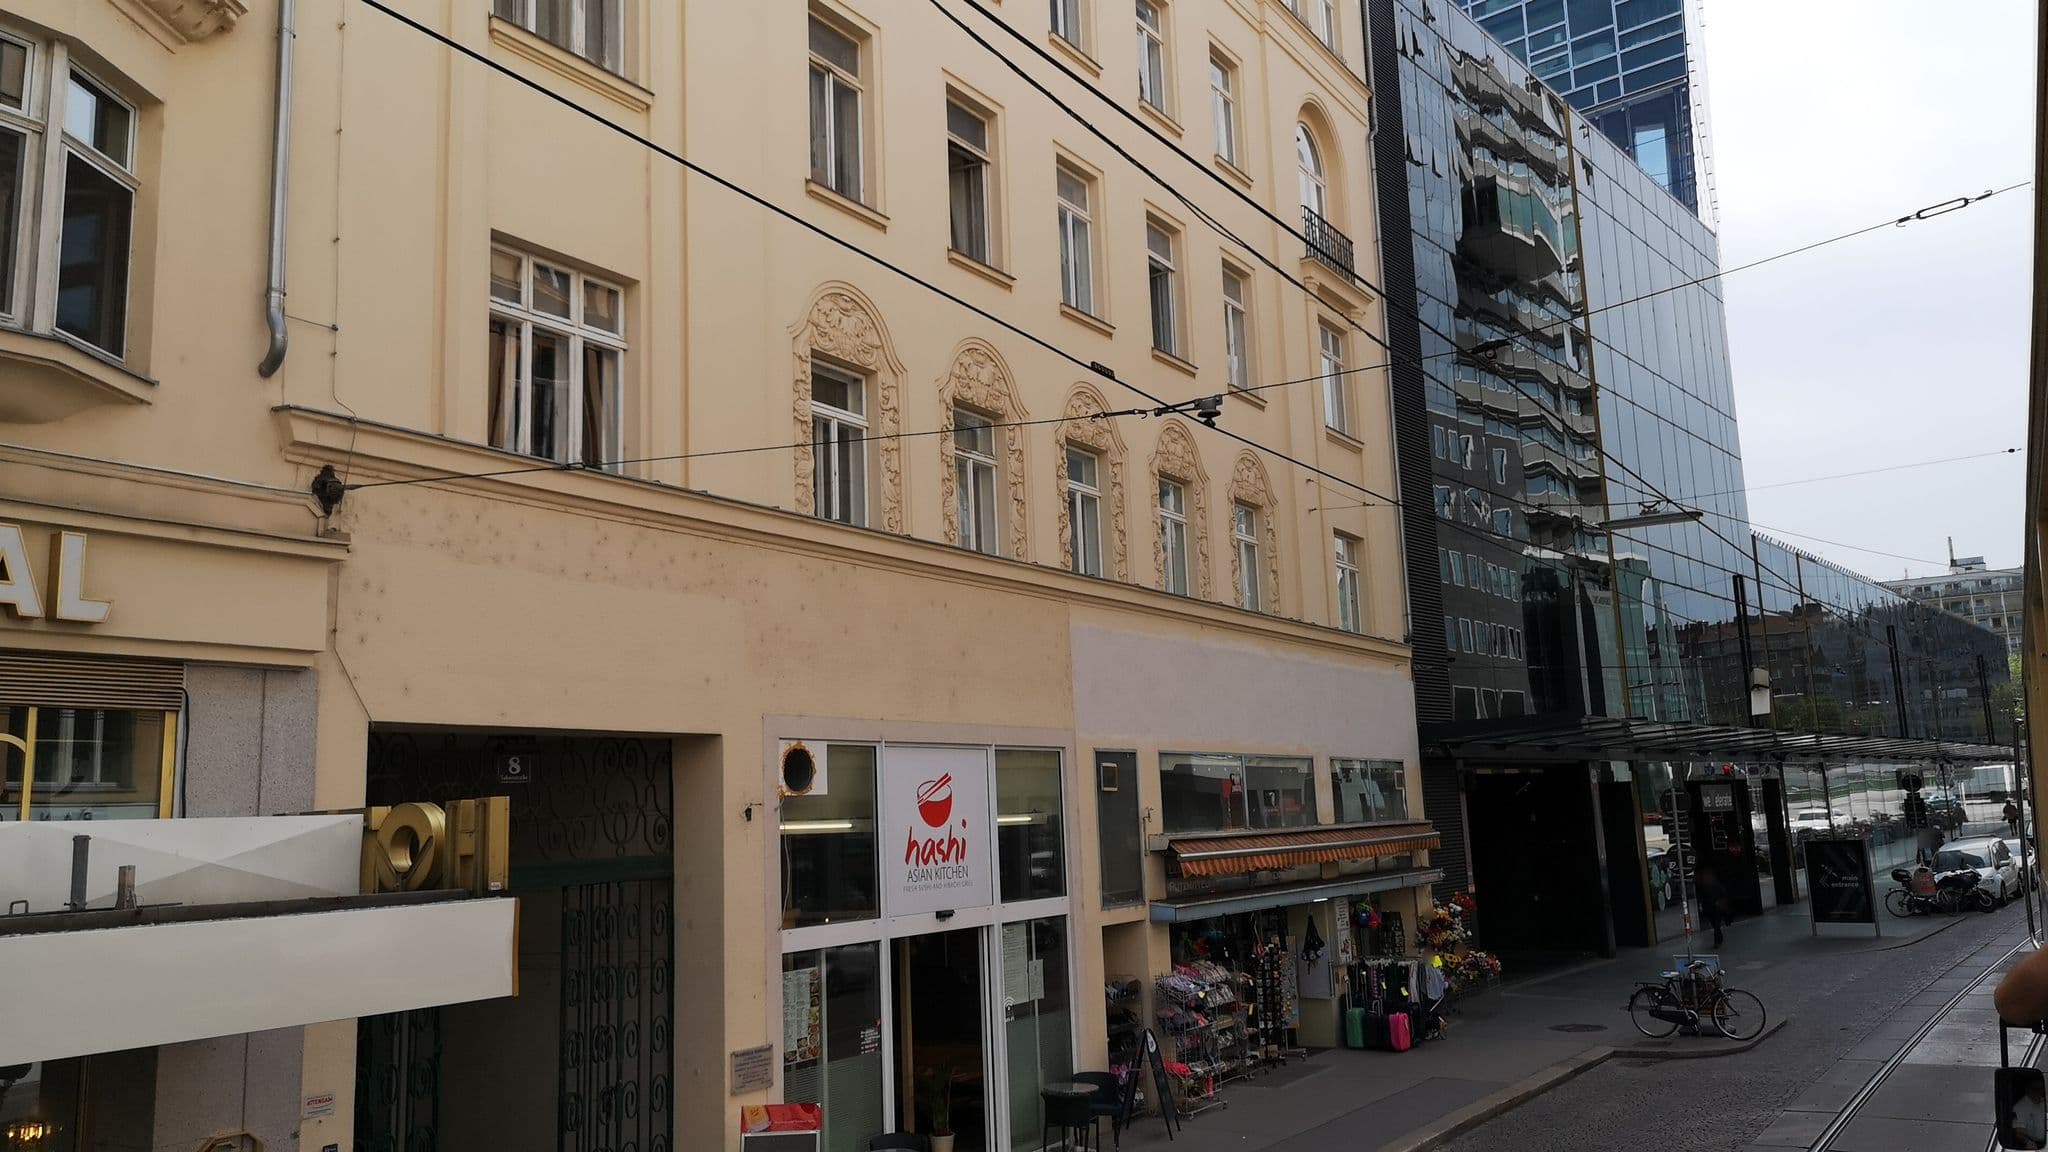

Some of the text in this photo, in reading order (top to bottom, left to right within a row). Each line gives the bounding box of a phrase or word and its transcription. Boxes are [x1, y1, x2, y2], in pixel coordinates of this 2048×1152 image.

[508, 757, 521, 774] 8
[905, 818, 966, 869] hashi
[907, 865, 969, 883] ASIAN KITCHEN
[932, 881, 943, 890] AND
[1831, 881, 1859, 889] entrance
